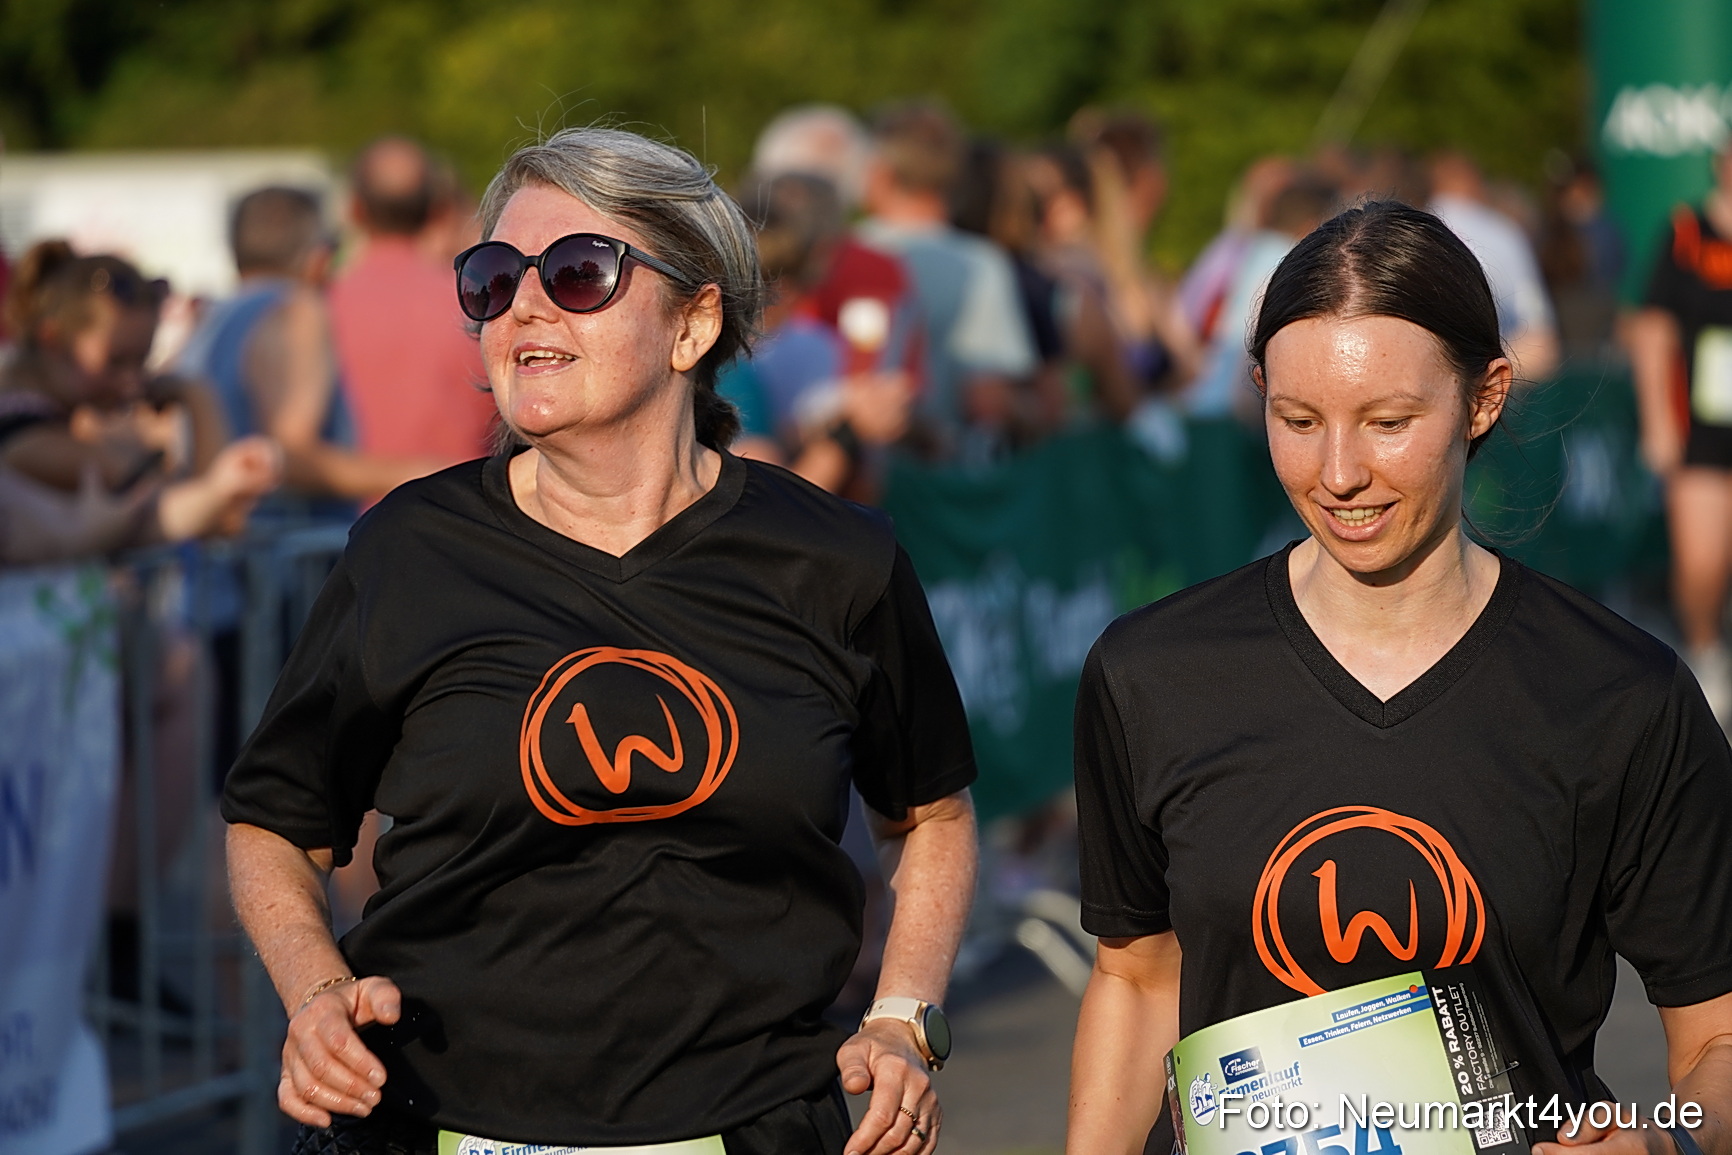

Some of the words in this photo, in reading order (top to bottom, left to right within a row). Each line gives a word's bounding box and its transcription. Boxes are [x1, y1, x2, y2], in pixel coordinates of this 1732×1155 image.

[1335, 1008, 1361, 1021] Laufen,
[1360, 1000, 1386, 1014] Joggen,
[1385, 992, 1411, 1005] Walken
[1431, 986, 1461, 1054] RABATT
[1447, 984, 1470, 1032] OUTLET
[1302, 1034, 1325, 1046] Essen,
[1323, 1026, 1351, 1039] Trinken,
[1350, 1018, 1373, 1031] Feiern,
[1372, 1006, 1412, 1024] Netzwerken
[1227, 1058, 1260, 1074] Fischer
[1453, 1055, 1466, 1070] %
[1462, 1033, 1487, 1092] FACTORY
[1252, 1077, 1302, 1103] neumarkt
[1457, 1071, 1474, 1096] 20
